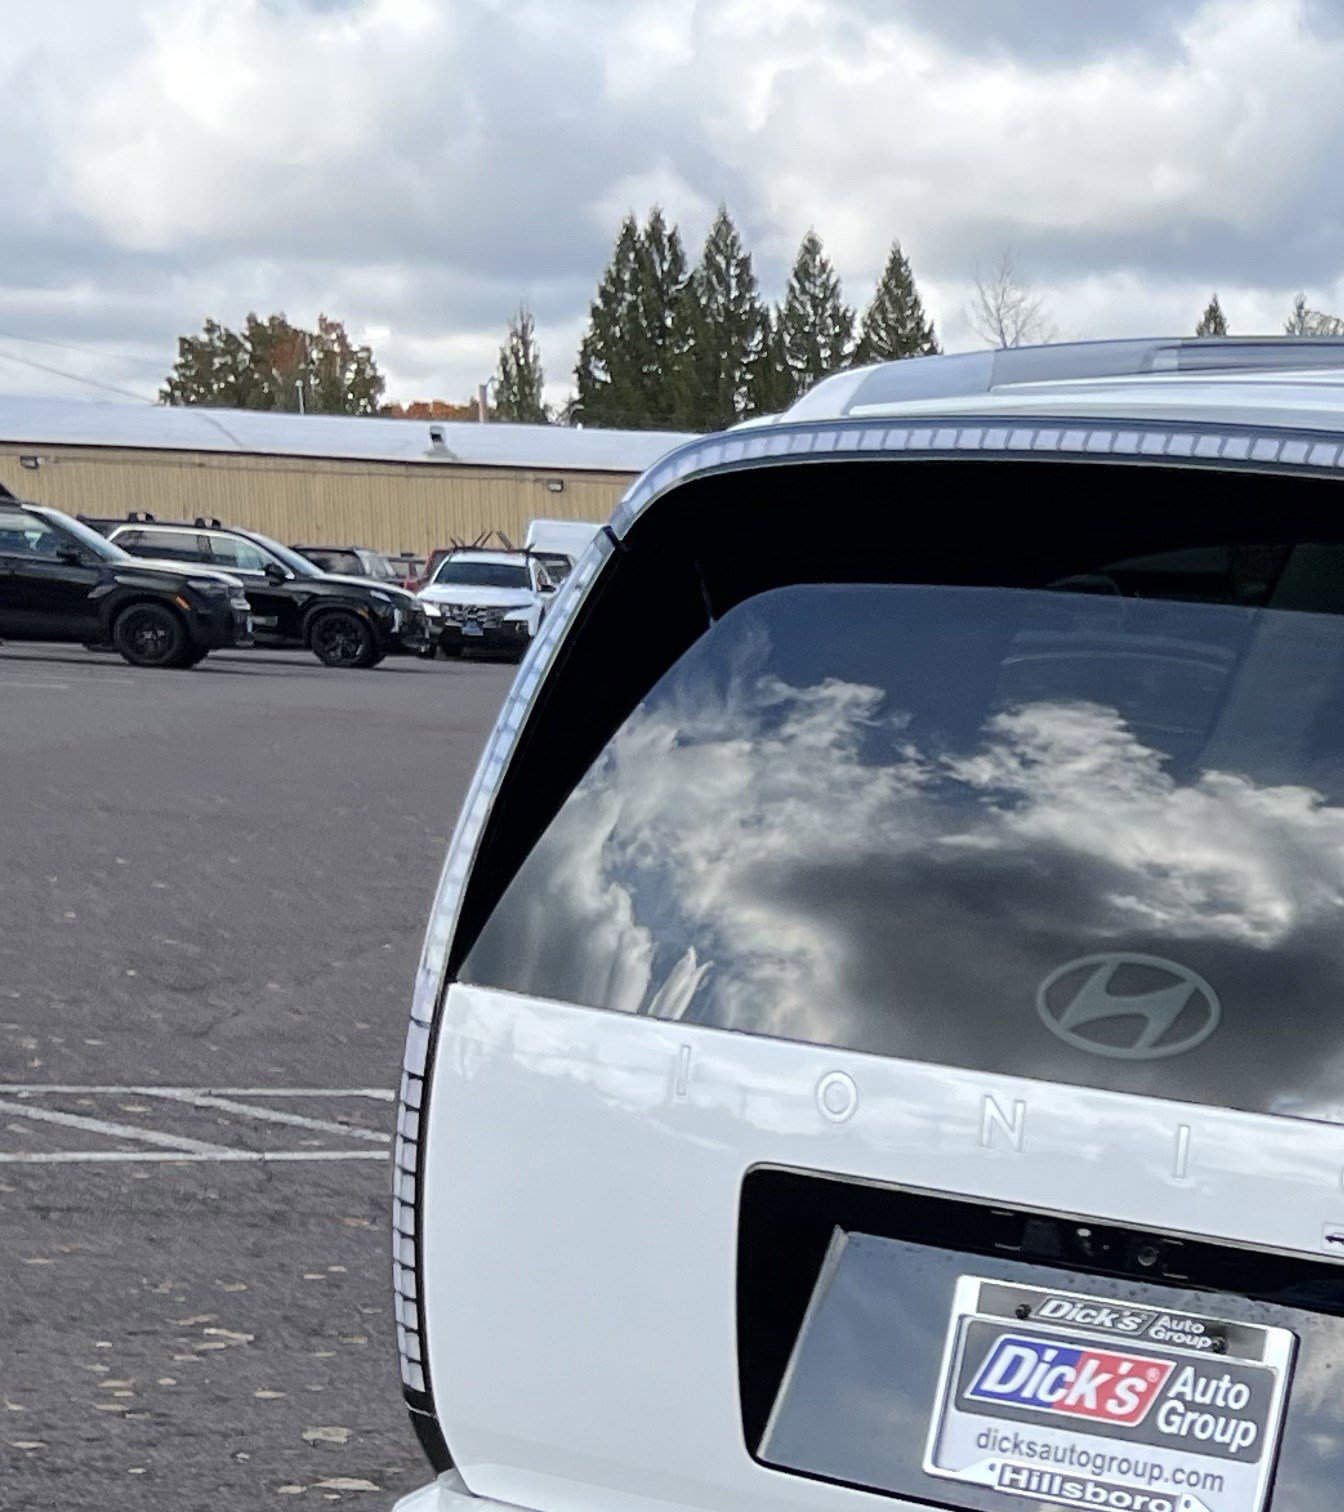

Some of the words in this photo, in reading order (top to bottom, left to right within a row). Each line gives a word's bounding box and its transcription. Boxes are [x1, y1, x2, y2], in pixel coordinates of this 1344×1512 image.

[1038, 1299, 1145, 1331] Dick's
[1154, 1314, 1206, 1335] Auto
[1148, 1327, 1213, 1349] Group
[978, 1343, 1149, 1416] Dick's
[1168, 1364, 1251, 1411] Auto
[1156, 1403, 1258, 1453] Group
[975, 1426, 1225, 1494] dicksautogroup.com
